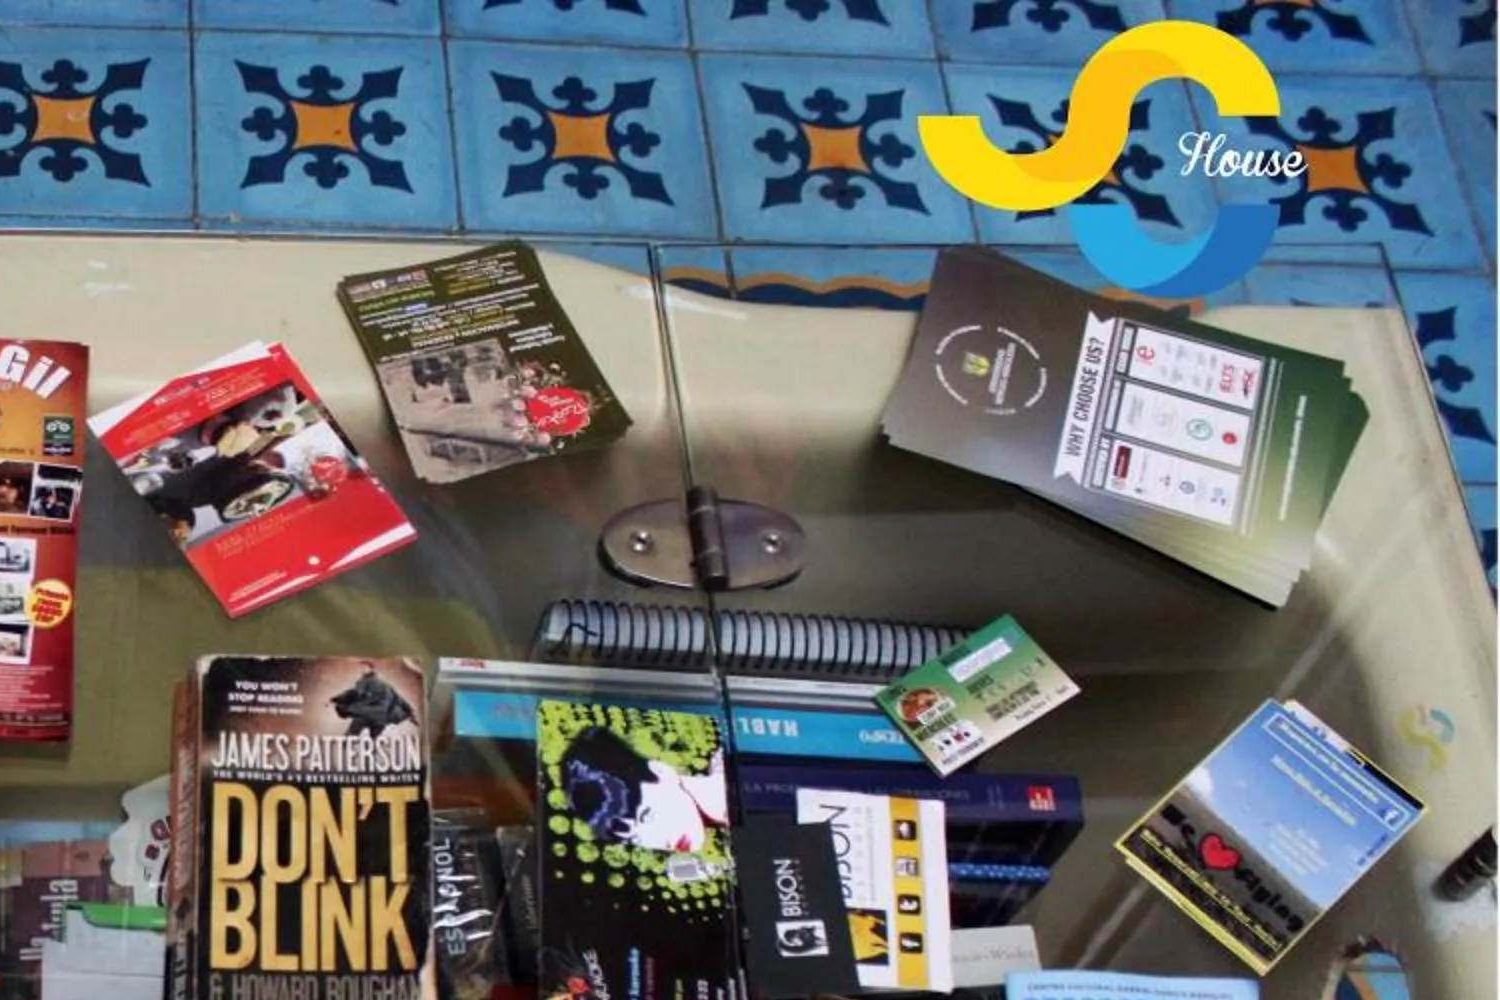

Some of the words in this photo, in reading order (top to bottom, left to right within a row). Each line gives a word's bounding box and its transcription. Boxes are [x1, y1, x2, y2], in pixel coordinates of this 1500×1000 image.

[1081, 335, 1105, 366] US?
[1070, 365, 1099, 423] CHOOSE
[1065, 423, 1087, 458] WHY
[228, 692, 256, 703] STOP
[234, 681, 259, 692] YOU
[212, 731, 290, 771] JAMES
[295, 730, 421, 772] PATTERSON
[306, 773, 376, 783] BESTSELLING
[212, 782, 421, 883] DON'T
[774, 860, 802, 916] BISON
[210, 876, 418, 971] BLINK
